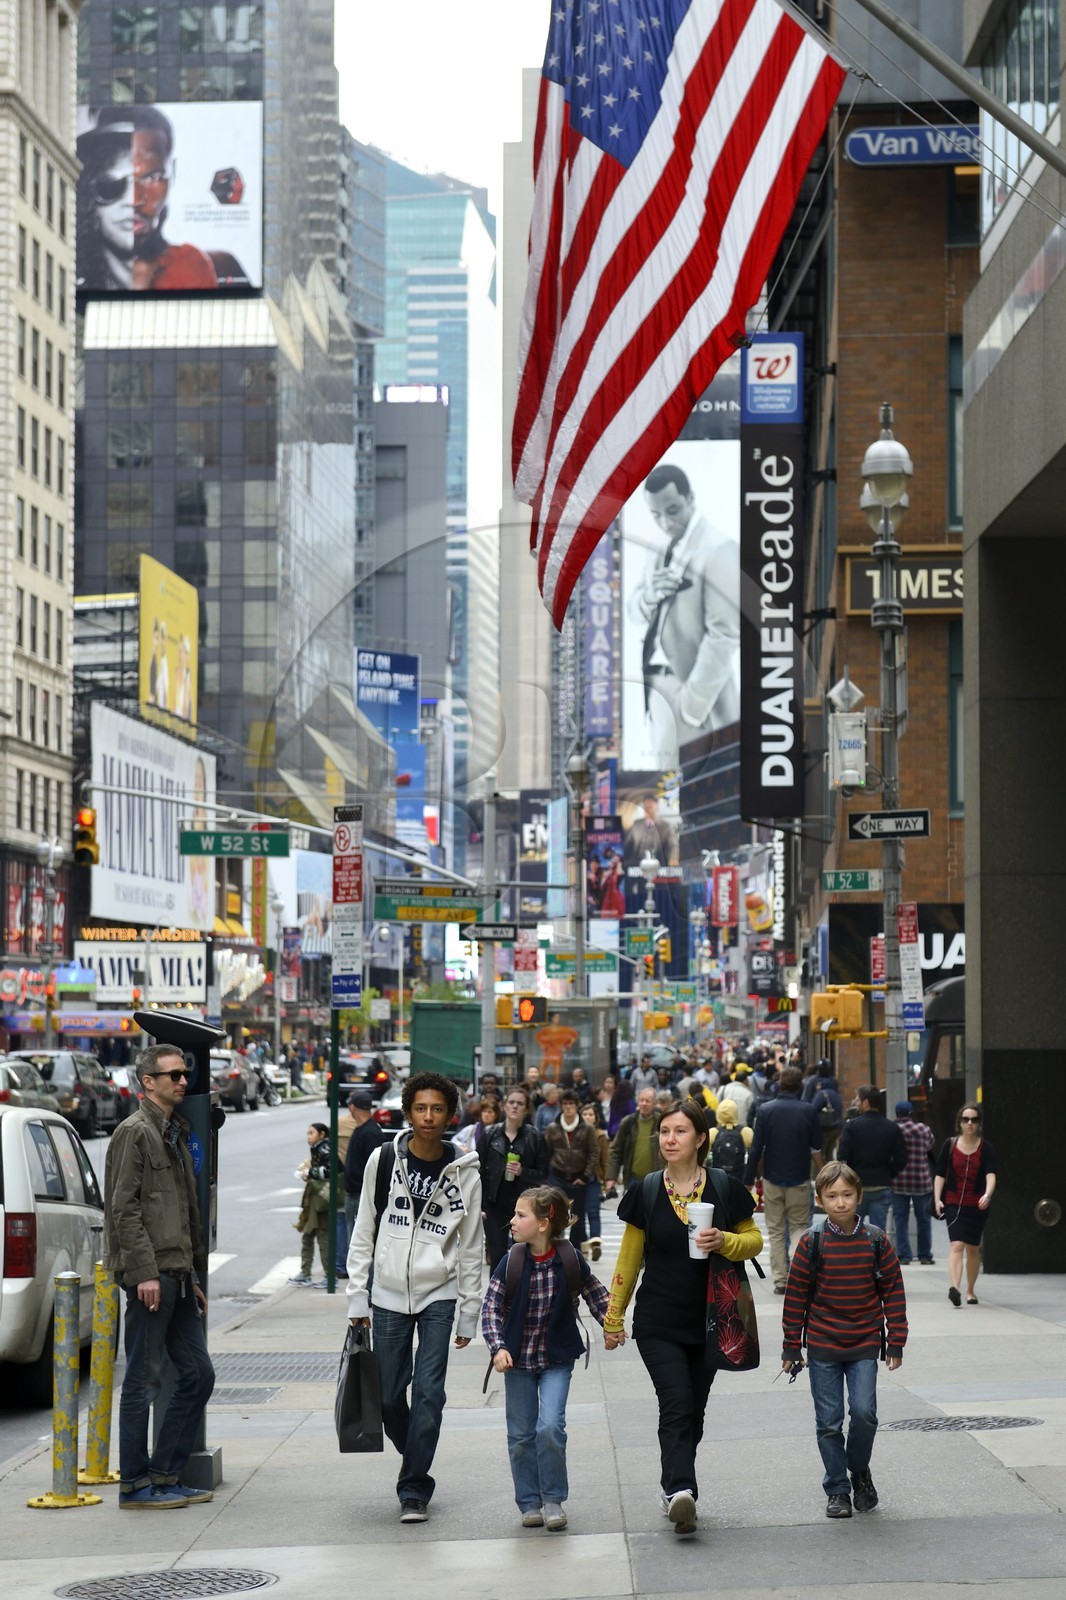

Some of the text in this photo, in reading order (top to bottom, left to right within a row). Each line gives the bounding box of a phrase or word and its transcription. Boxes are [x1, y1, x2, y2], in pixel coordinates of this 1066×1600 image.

[849, 132, 918, 156] Van
[589, 557, 613, 702] SQUARE
[359, 652, 391, 671] GET ON
[358, 669, 392, 689] ISLAND
[861, 818, 920, 833] ONE WAY
[201, 835, 269, 852] W 52 St
[587, 832, 622, 843] MEMPHIS
[772, 830, 785, 941] McDonald's
[826, 873, 836, 889] W
[839, 873, 853, 889] 52
[406, 908, 426, 918] USE
[446, 909, 467, 919] AVE
[81, 927, 138, 941] WINTER
[467, 927, 511, 937] ONE WAY
